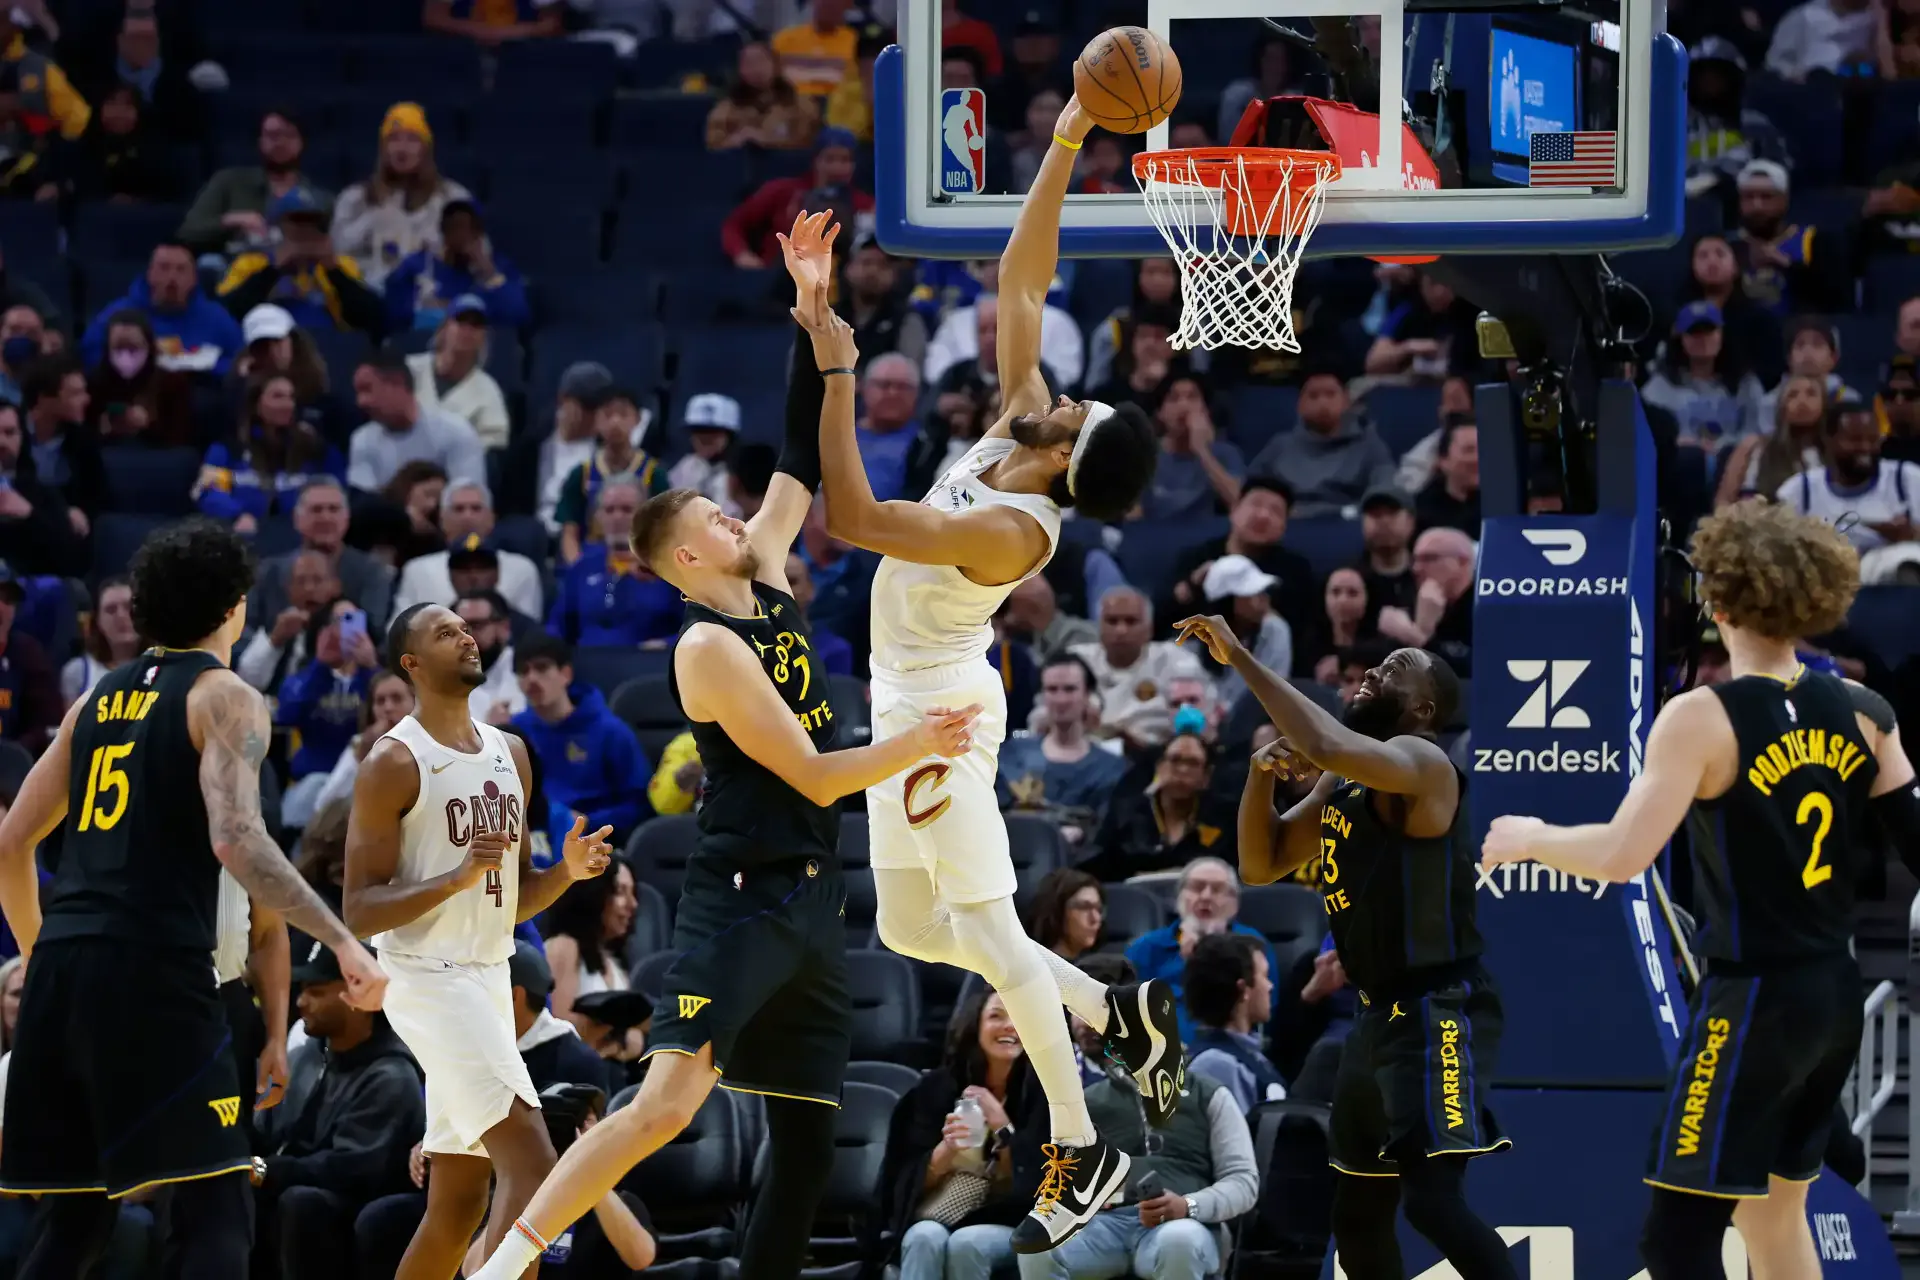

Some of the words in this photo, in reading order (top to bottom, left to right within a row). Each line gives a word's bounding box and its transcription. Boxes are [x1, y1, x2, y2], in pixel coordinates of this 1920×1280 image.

[946, 171, 968, 188] NBA
[1478, 577, 1628, 596] DOORDASH
[793, 654, 811, 701] 7
[1474, 741, 1621, 772] zendesk
[1748, 728, 1867, 796] PODZIEMSKI
[77, 741, 135, 832] 15
[445, 793, 521, 848] CAVS
[1796, 791, 1833, 890] 2
[486, 868, 503, 908] 4
[1440, 1020, 1464, 1130] WARRIORS
[1675, 1017, 1730, 1157] WARRIORS
[1813, 1212, 1857, 1261] KAISER
